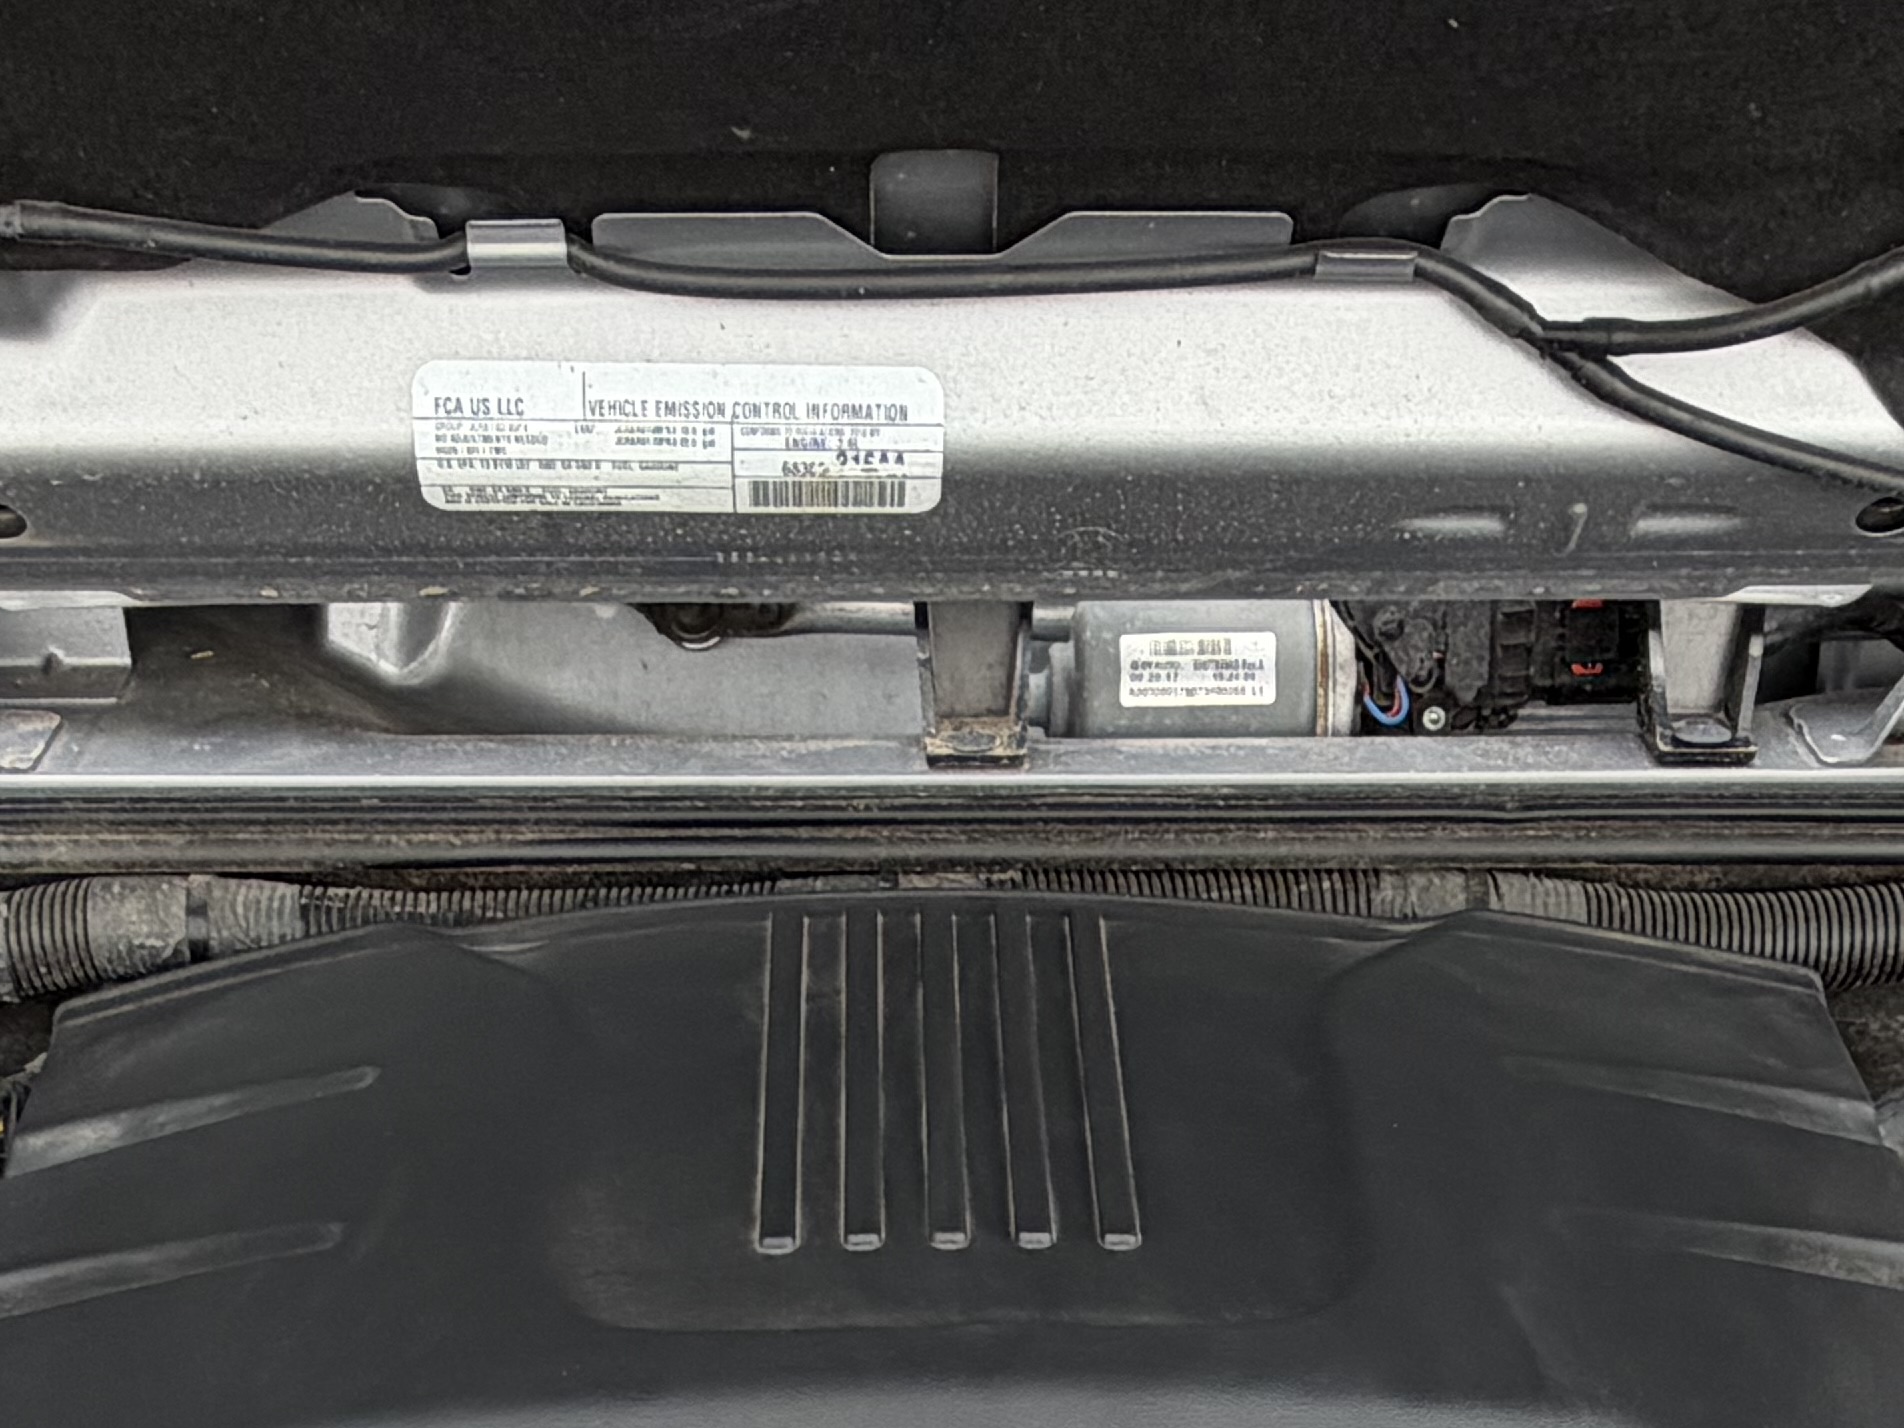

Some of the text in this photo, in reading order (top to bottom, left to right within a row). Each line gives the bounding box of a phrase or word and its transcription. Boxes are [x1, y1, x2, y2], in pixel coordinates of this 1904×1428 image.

[433, 397, 525, 417] FCA US LLC
[589, 399, 909, 422] VEHICLE EMISSION CONTROL INFORMATION
